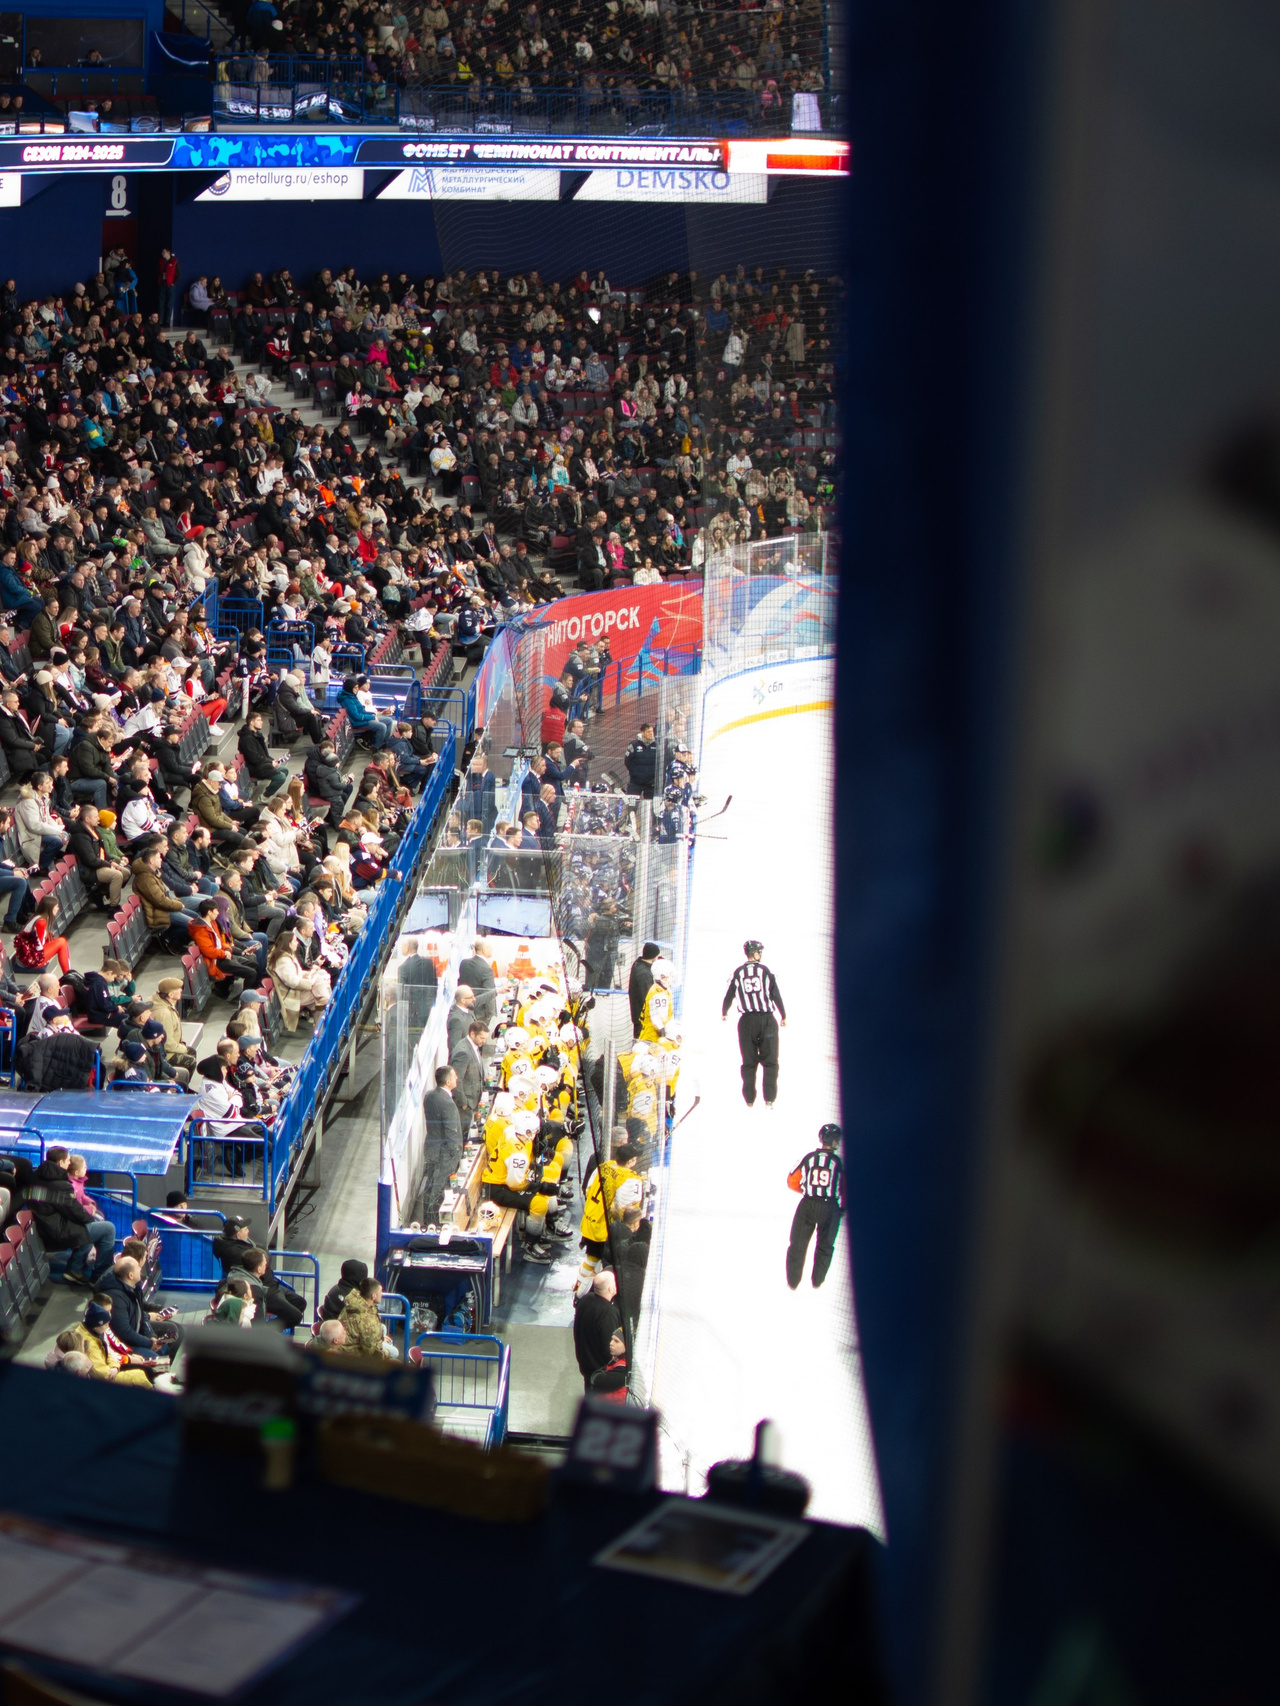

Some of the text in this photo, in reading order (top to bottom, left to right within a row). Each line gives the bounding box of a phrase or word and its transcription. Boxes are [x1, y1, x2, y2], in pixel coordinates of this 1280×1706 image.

[23, 145, 124, 162] СЕЗОН 2024-2025
[403, 143, 470, 158] ФОНБЕТ
[474, 144, 573, 160] ЧЕМПИОНАТ
[236, 171, 349, 187] metallurg.ru/eshop
[616, 170, 731, 190] DEMSKO
[111, 175, 127, 209] 8
[744, 977, 761, 993] 63
[512, 1158, 526, 1169] 52
[812, 1169, 830, 1187] 19
